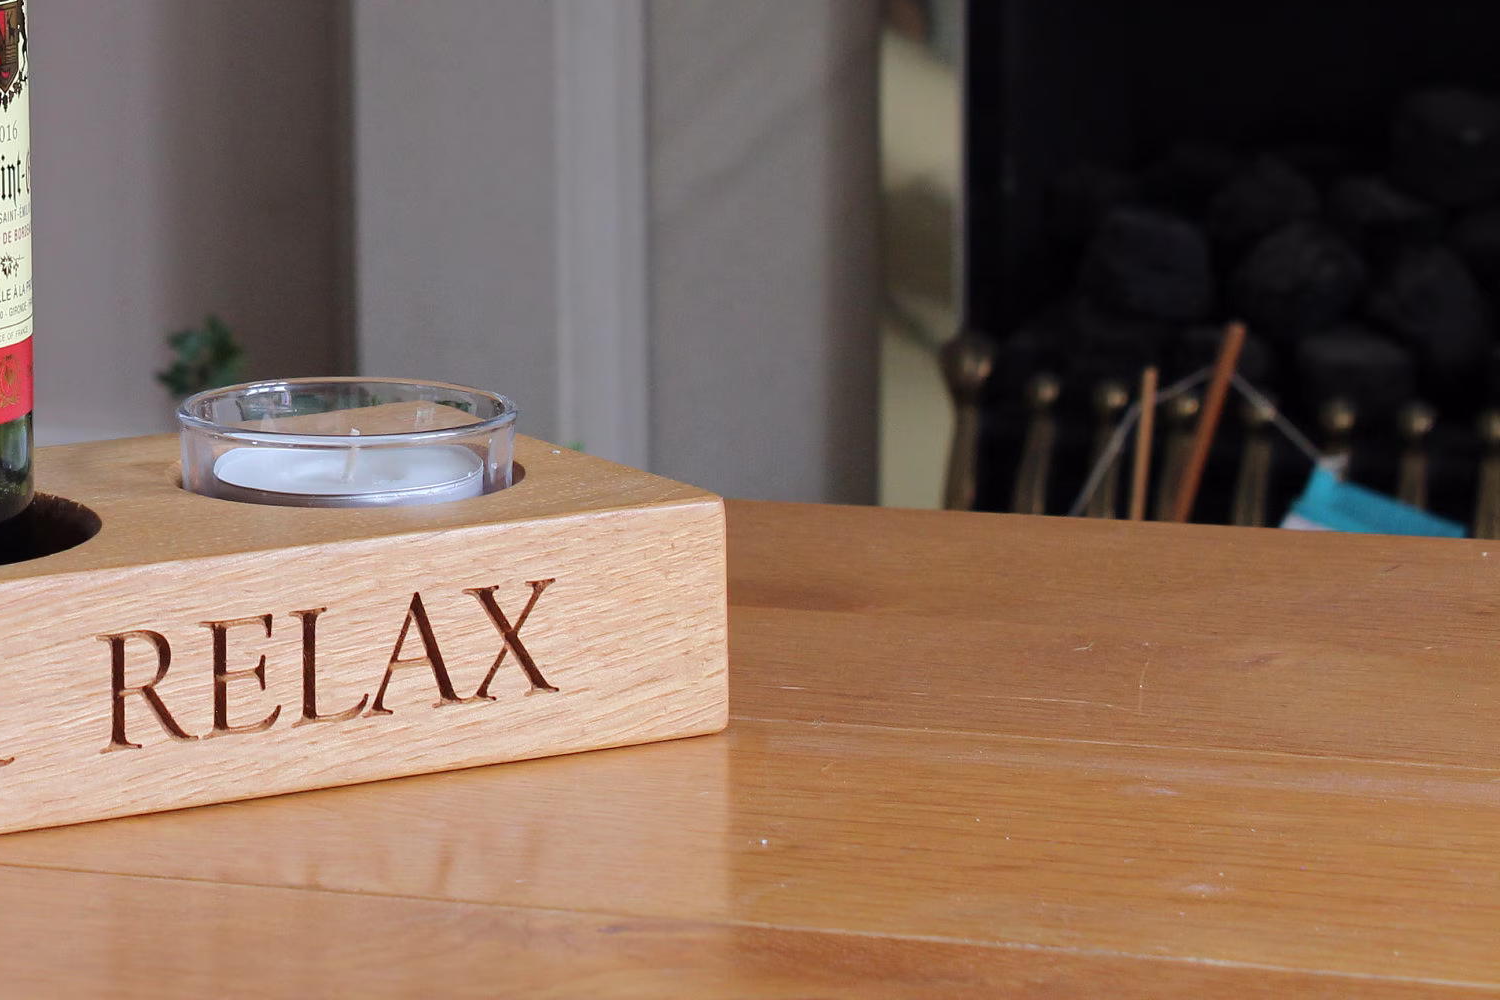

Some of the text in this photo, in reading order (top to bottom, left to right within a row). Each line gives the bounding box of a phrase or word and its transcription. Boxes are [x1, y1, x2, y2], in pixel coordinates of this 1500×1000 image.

[2, 230, 12, 245] DE
[13, 283, 19, 299] À
[19, 283, 26, 297] LA
[7, 331, 14, 341] OF
[96, 577, 560, 753] RELAX
